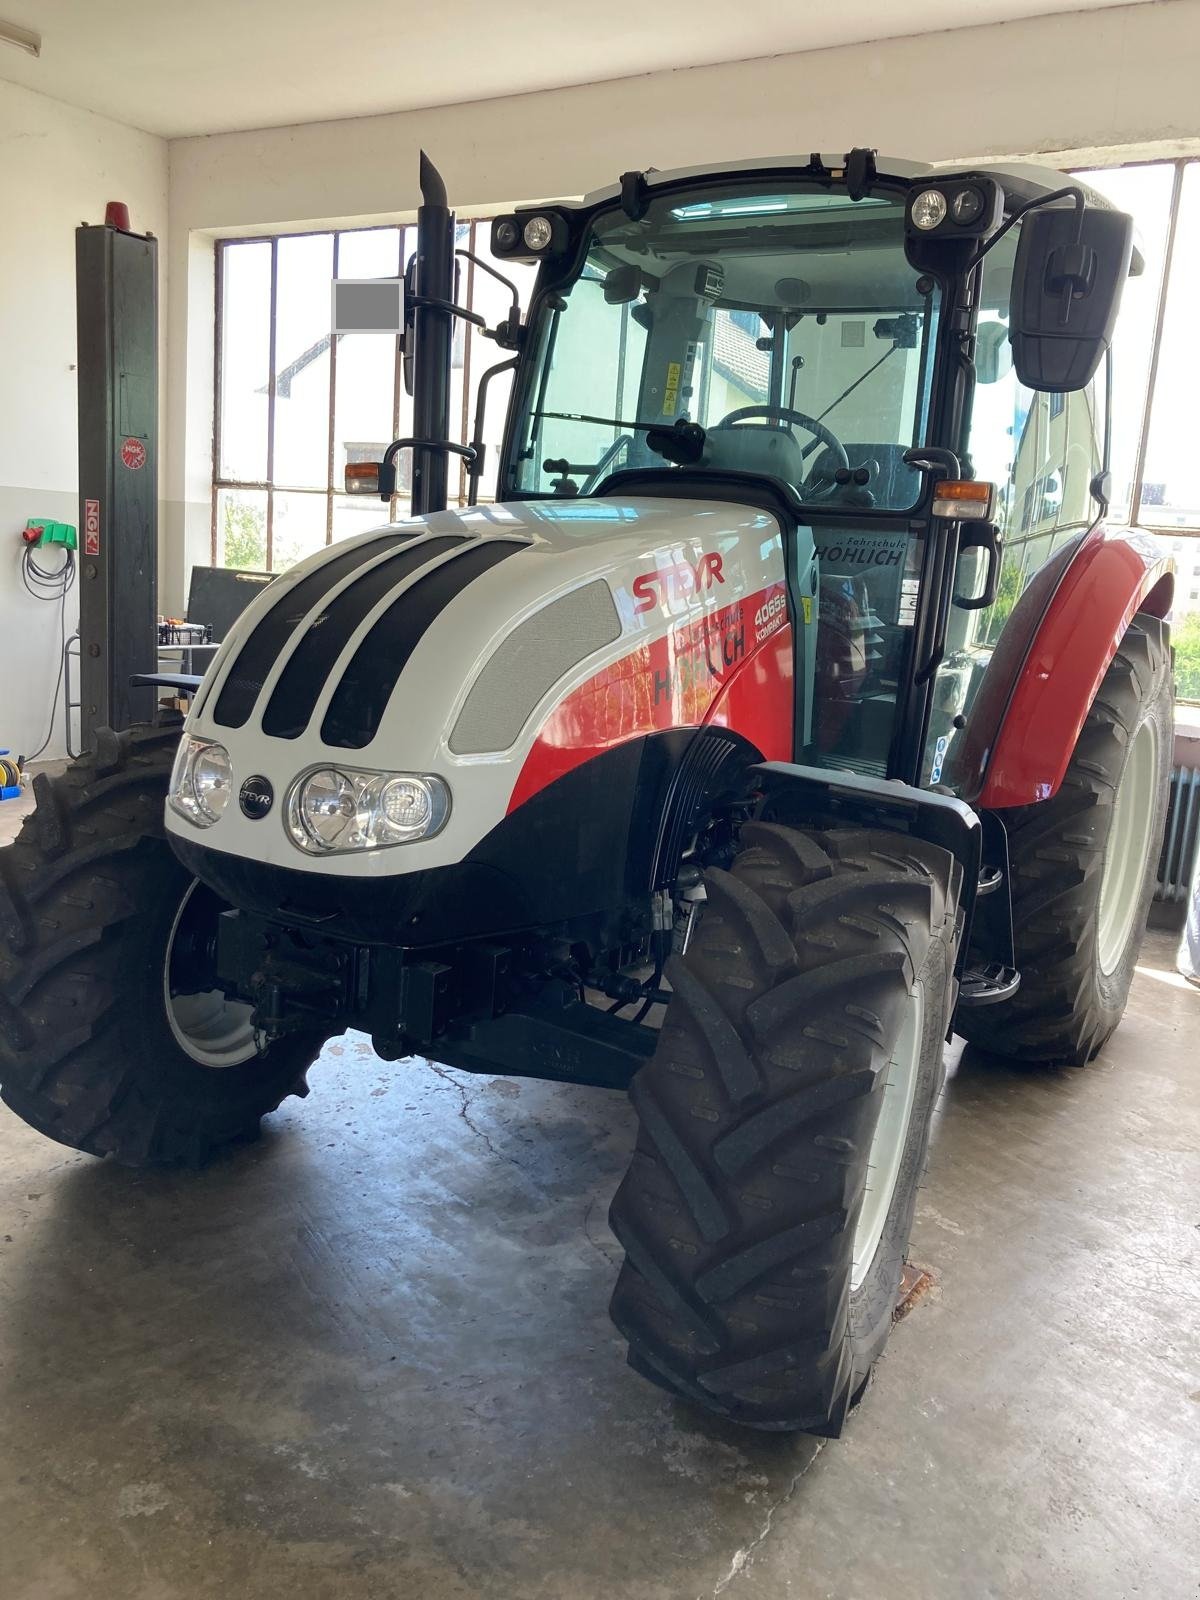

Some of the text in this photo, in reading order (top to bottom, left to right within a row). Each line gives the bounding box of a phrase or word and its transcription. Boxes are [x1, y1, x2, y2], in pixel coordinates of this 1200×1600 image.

[125, 445, 142, 453] NGK
[87, 502, 98, 545] NGK
[811, 541, 903, 566] HÖHLICH
[847, 537, 907, 549] Fahrschule
[632, 551, 725, 616] STEYR
[755, 613, 783, 643] KOMPAKT
